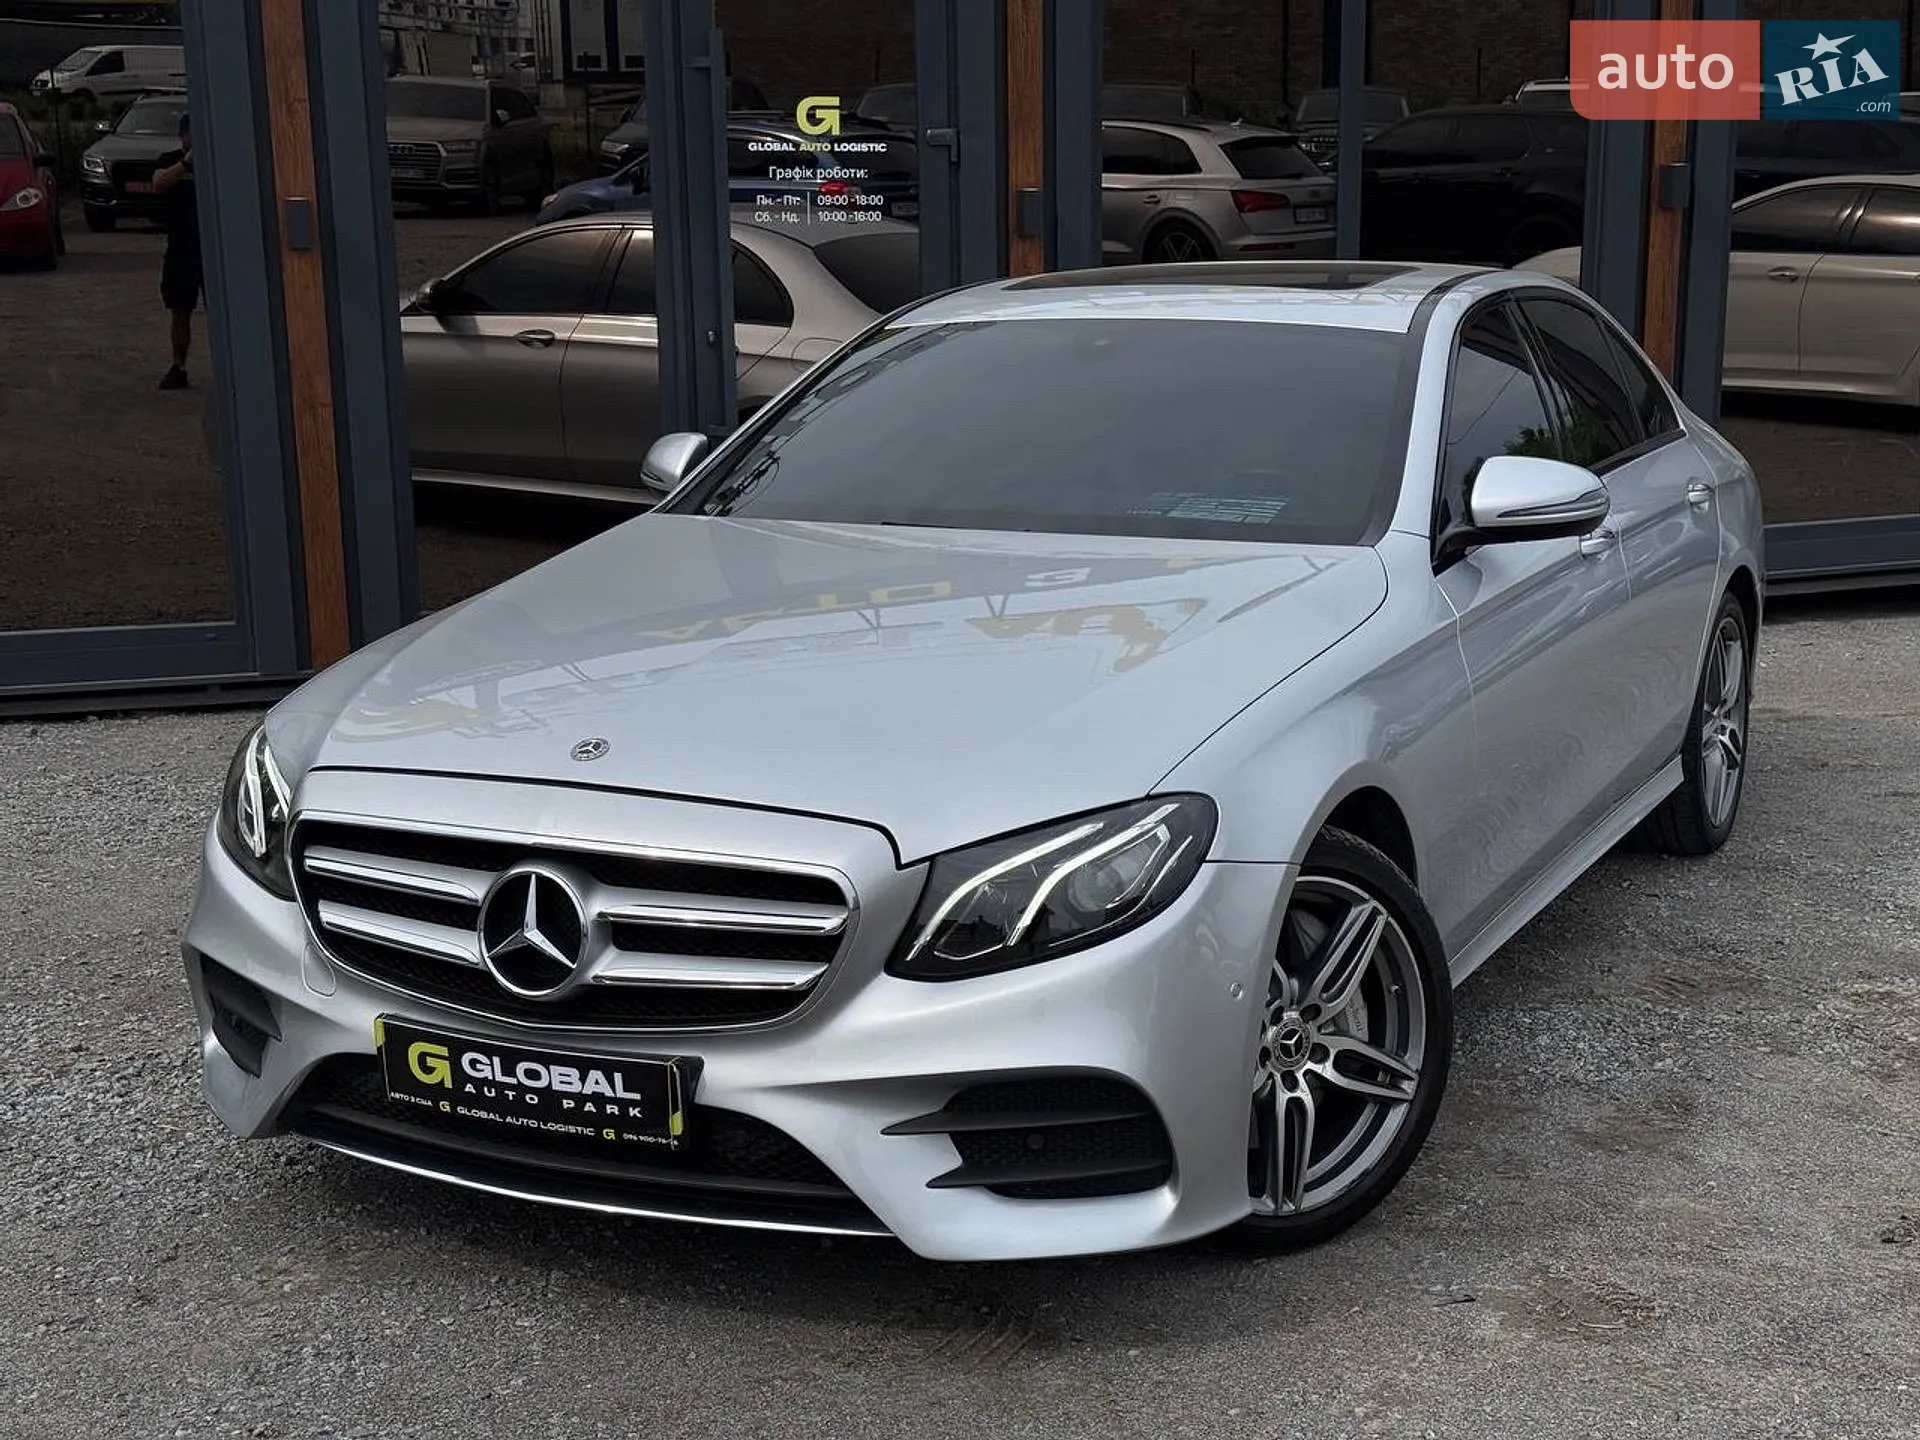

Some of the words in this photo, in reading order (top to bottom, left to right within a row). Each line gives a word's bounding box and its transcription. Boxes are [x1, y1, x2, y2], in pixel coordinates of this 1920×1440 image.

[748, 142, 796, 152] GLOBAL
[799, 142, 831, 152] AUTO
[833, 142, 887, 152] LOGISTIC
[768, 166, 813, 181] Графік
[817, 166, 869, 181] роботи:
[460, 1051, 642, 1101] GLOBAL
[464, 1083, 539, 1105] AUTO
[562, 1099, 643, 1118] PARK
[456, 1106, 503, 1122] GLOBAL
[505, 1116, 538, 1128] AUTO
[540, 1120, 596, 1137] LOGISTIC
